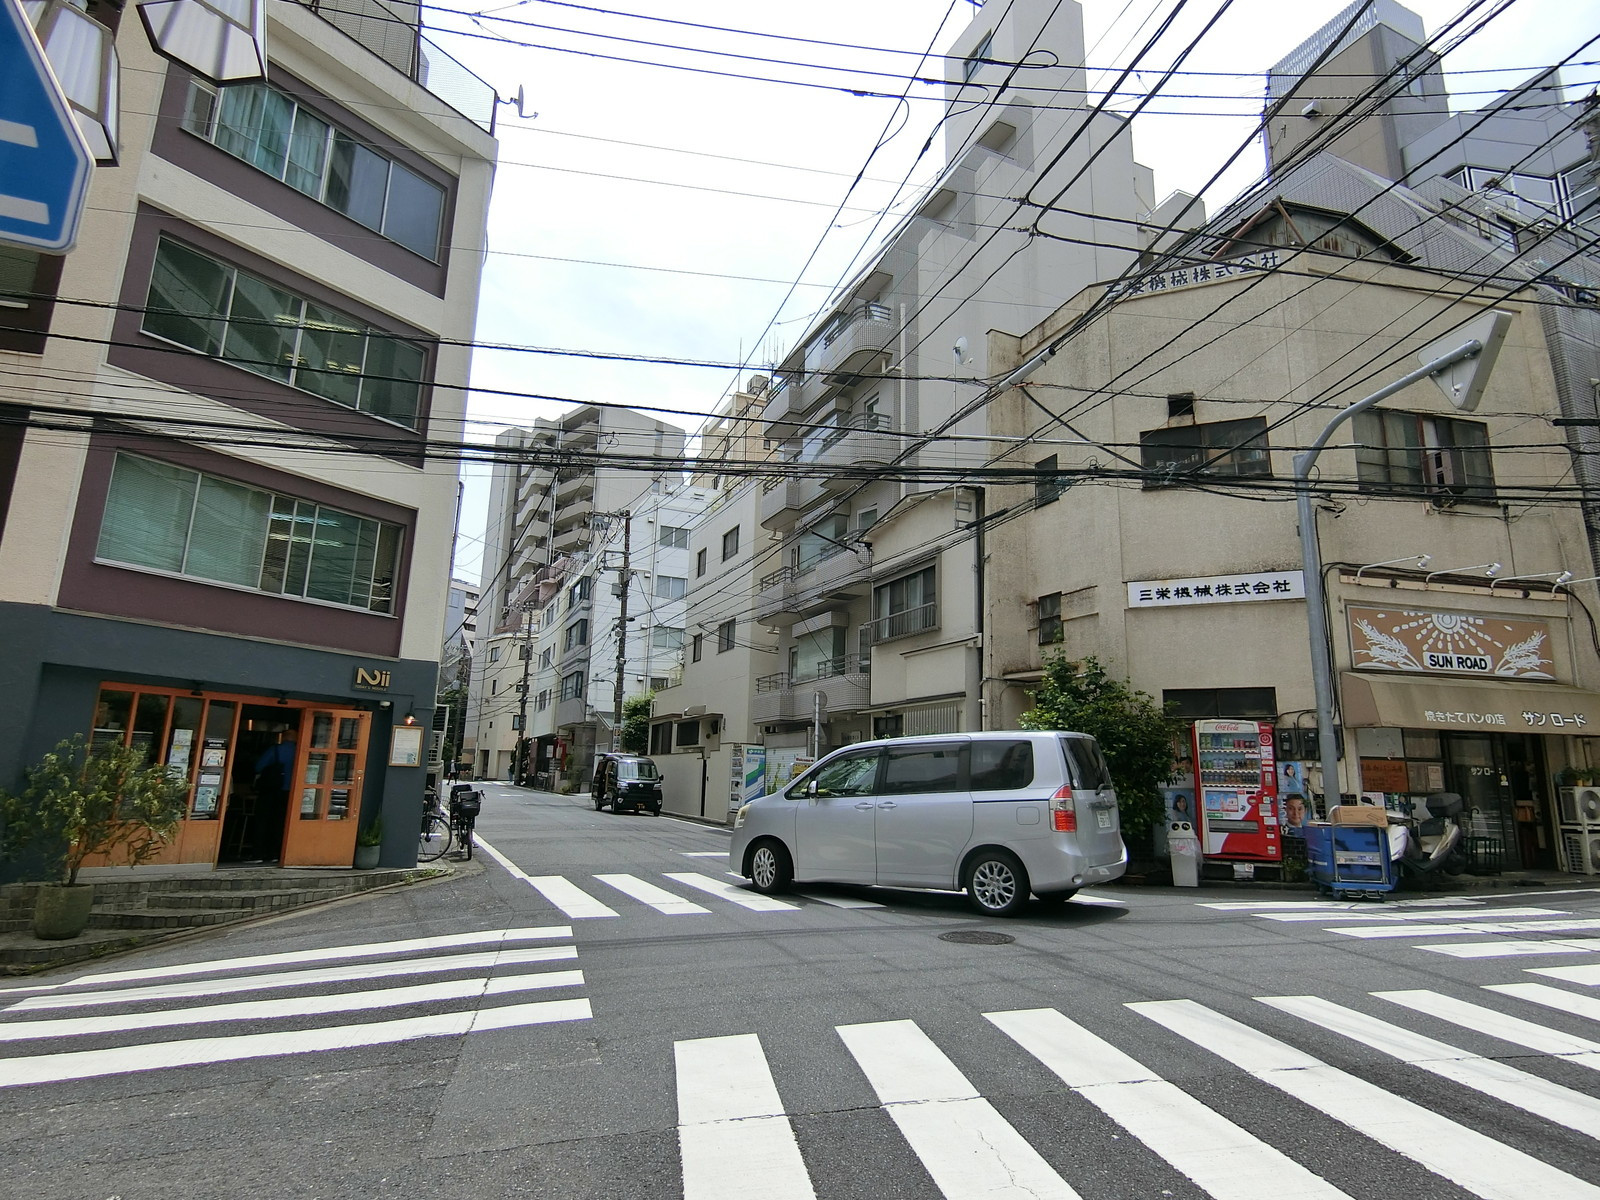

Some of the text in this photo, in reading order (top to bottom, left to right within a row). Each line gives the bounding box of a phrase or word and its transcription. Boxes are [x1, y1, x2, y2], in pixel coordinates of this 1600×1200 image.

[1139, 579, 1291, 602] 三栄機械株式会社
[1429, 654, 1487, 670] SUN ROAD
[1424, 710, 1506, 726] 焼きたてパンの店
